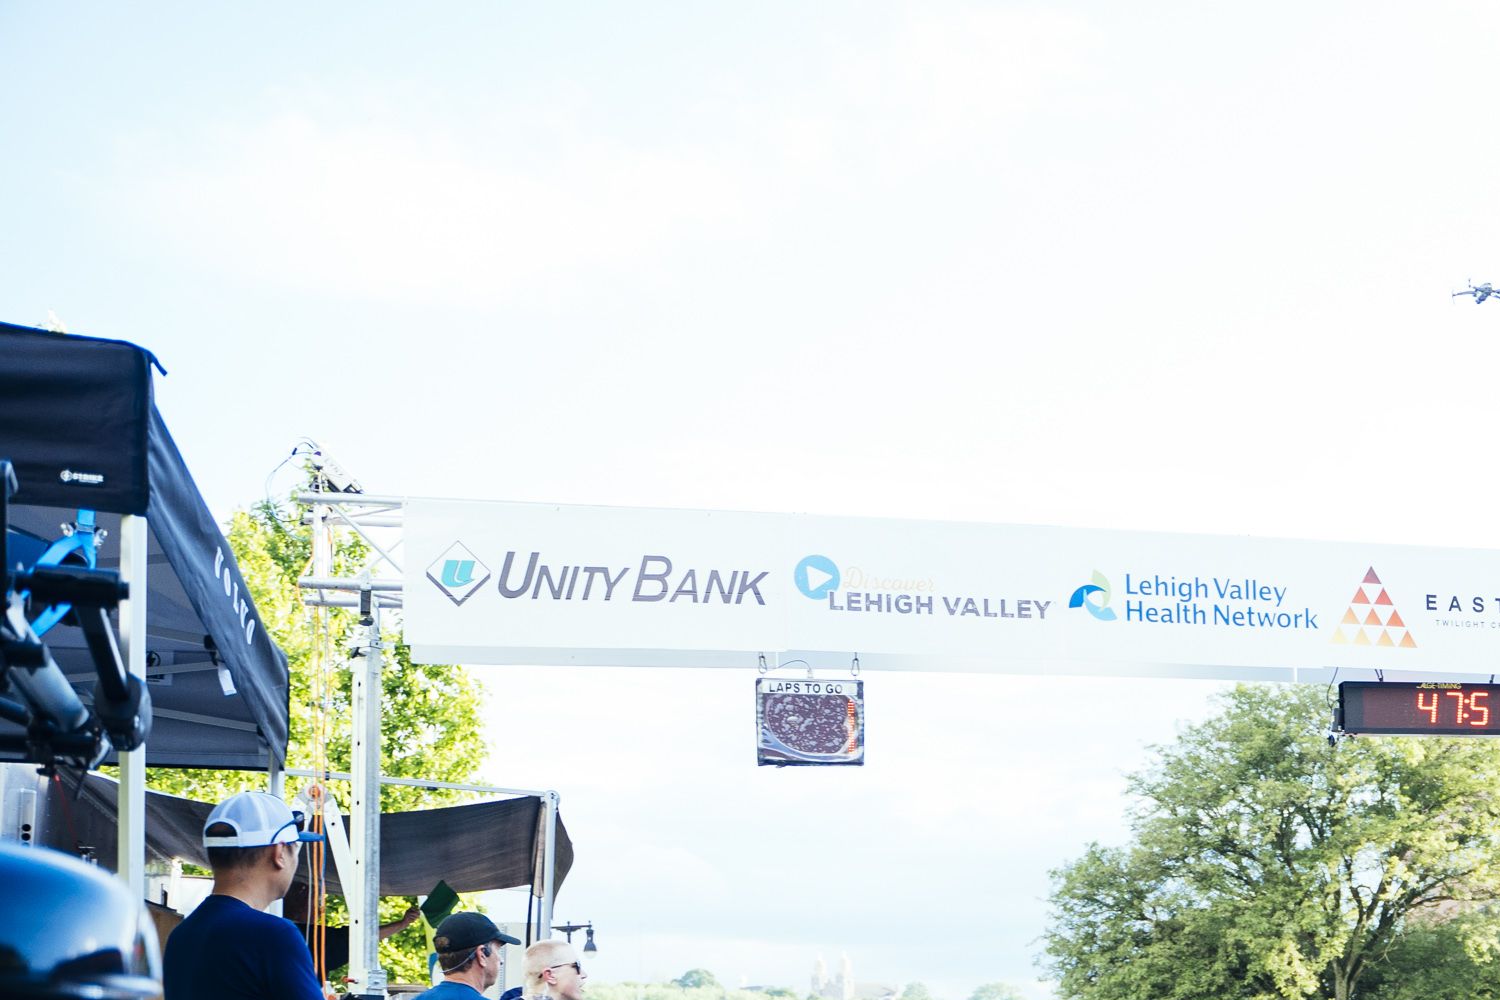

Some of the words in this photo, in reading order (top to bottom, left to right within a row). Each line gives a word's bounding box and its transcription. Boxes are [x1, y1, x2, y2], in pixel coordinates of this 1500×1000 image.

[498, 551, 631, 600] UNITY
[632, 555, 769, 605] BANK
[1126, 573, 1208, 602] Lehigh
[1213, 578, 1287, 607] Valley
[215, 546, 255, 645] VOLVO
[829, 591, 933, 615] LEHIGH
[942, 596, 1051, 619] VALLEY
[1126, 600, 1206, 625] Health
[1213, 603, 1319, 629] Network
[1435, 619, 1486, 629] TWILIGHT
[769, 682, 800, 693] LAPS
[805, 683, 820, 694] TO
[826, 684, 842, 694] GO
